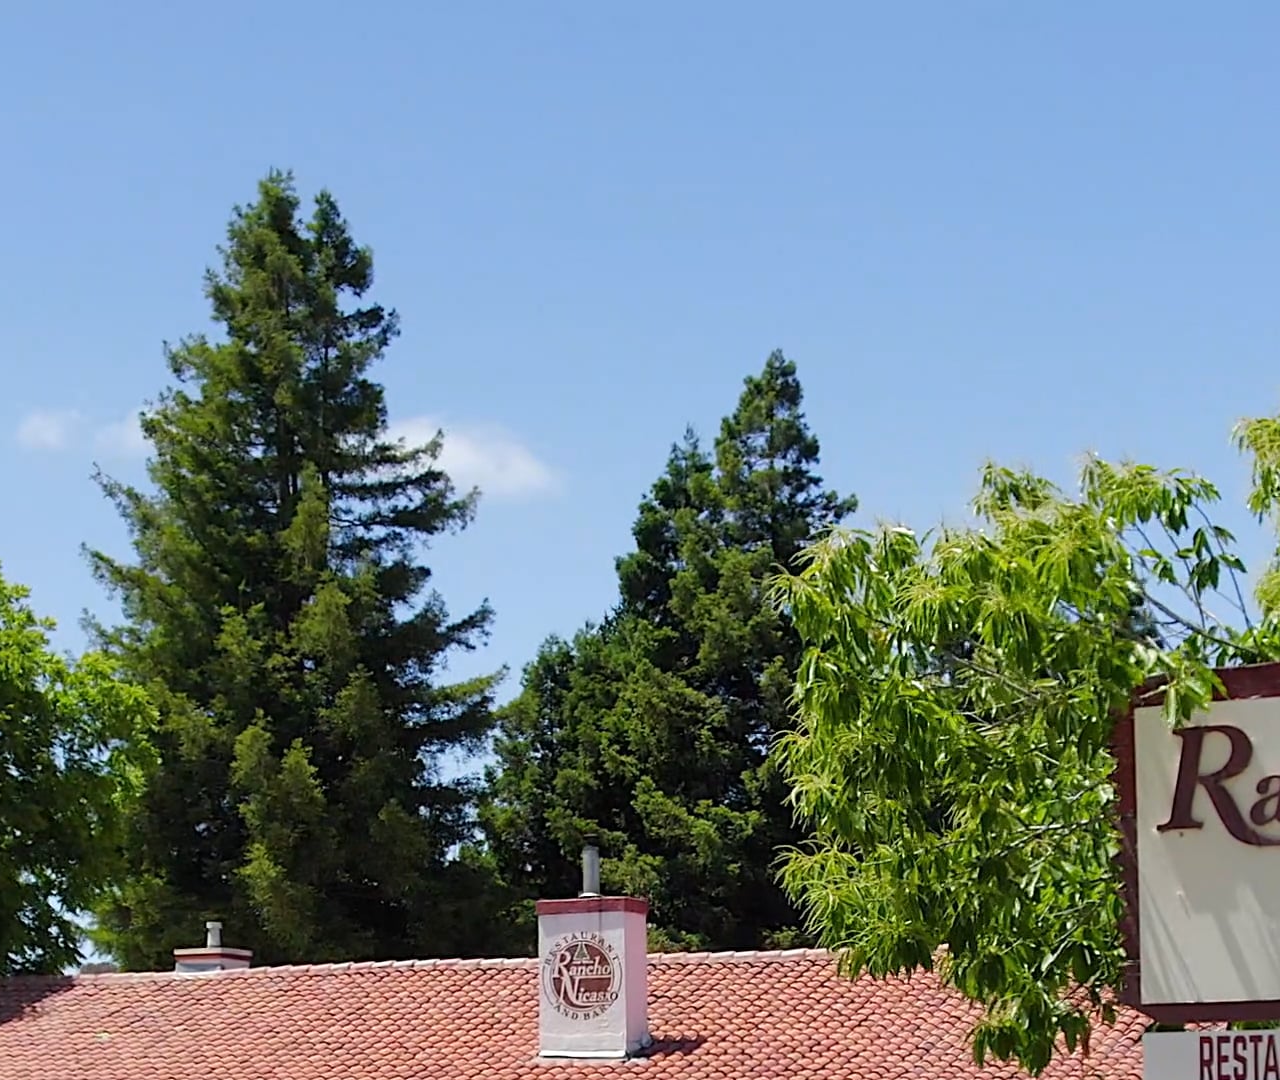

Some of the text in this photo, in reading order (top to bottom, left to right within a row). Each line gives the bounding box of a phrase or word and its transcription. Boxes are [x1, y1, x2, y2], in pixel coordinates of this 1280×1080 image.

[545, 931, 620, 966] RESTAURANT
[552, 950, 612, 979] Rancho
[559, 976, 619, 1003] Nicasio
[554, 1004, 609, 1020] AND BAR
